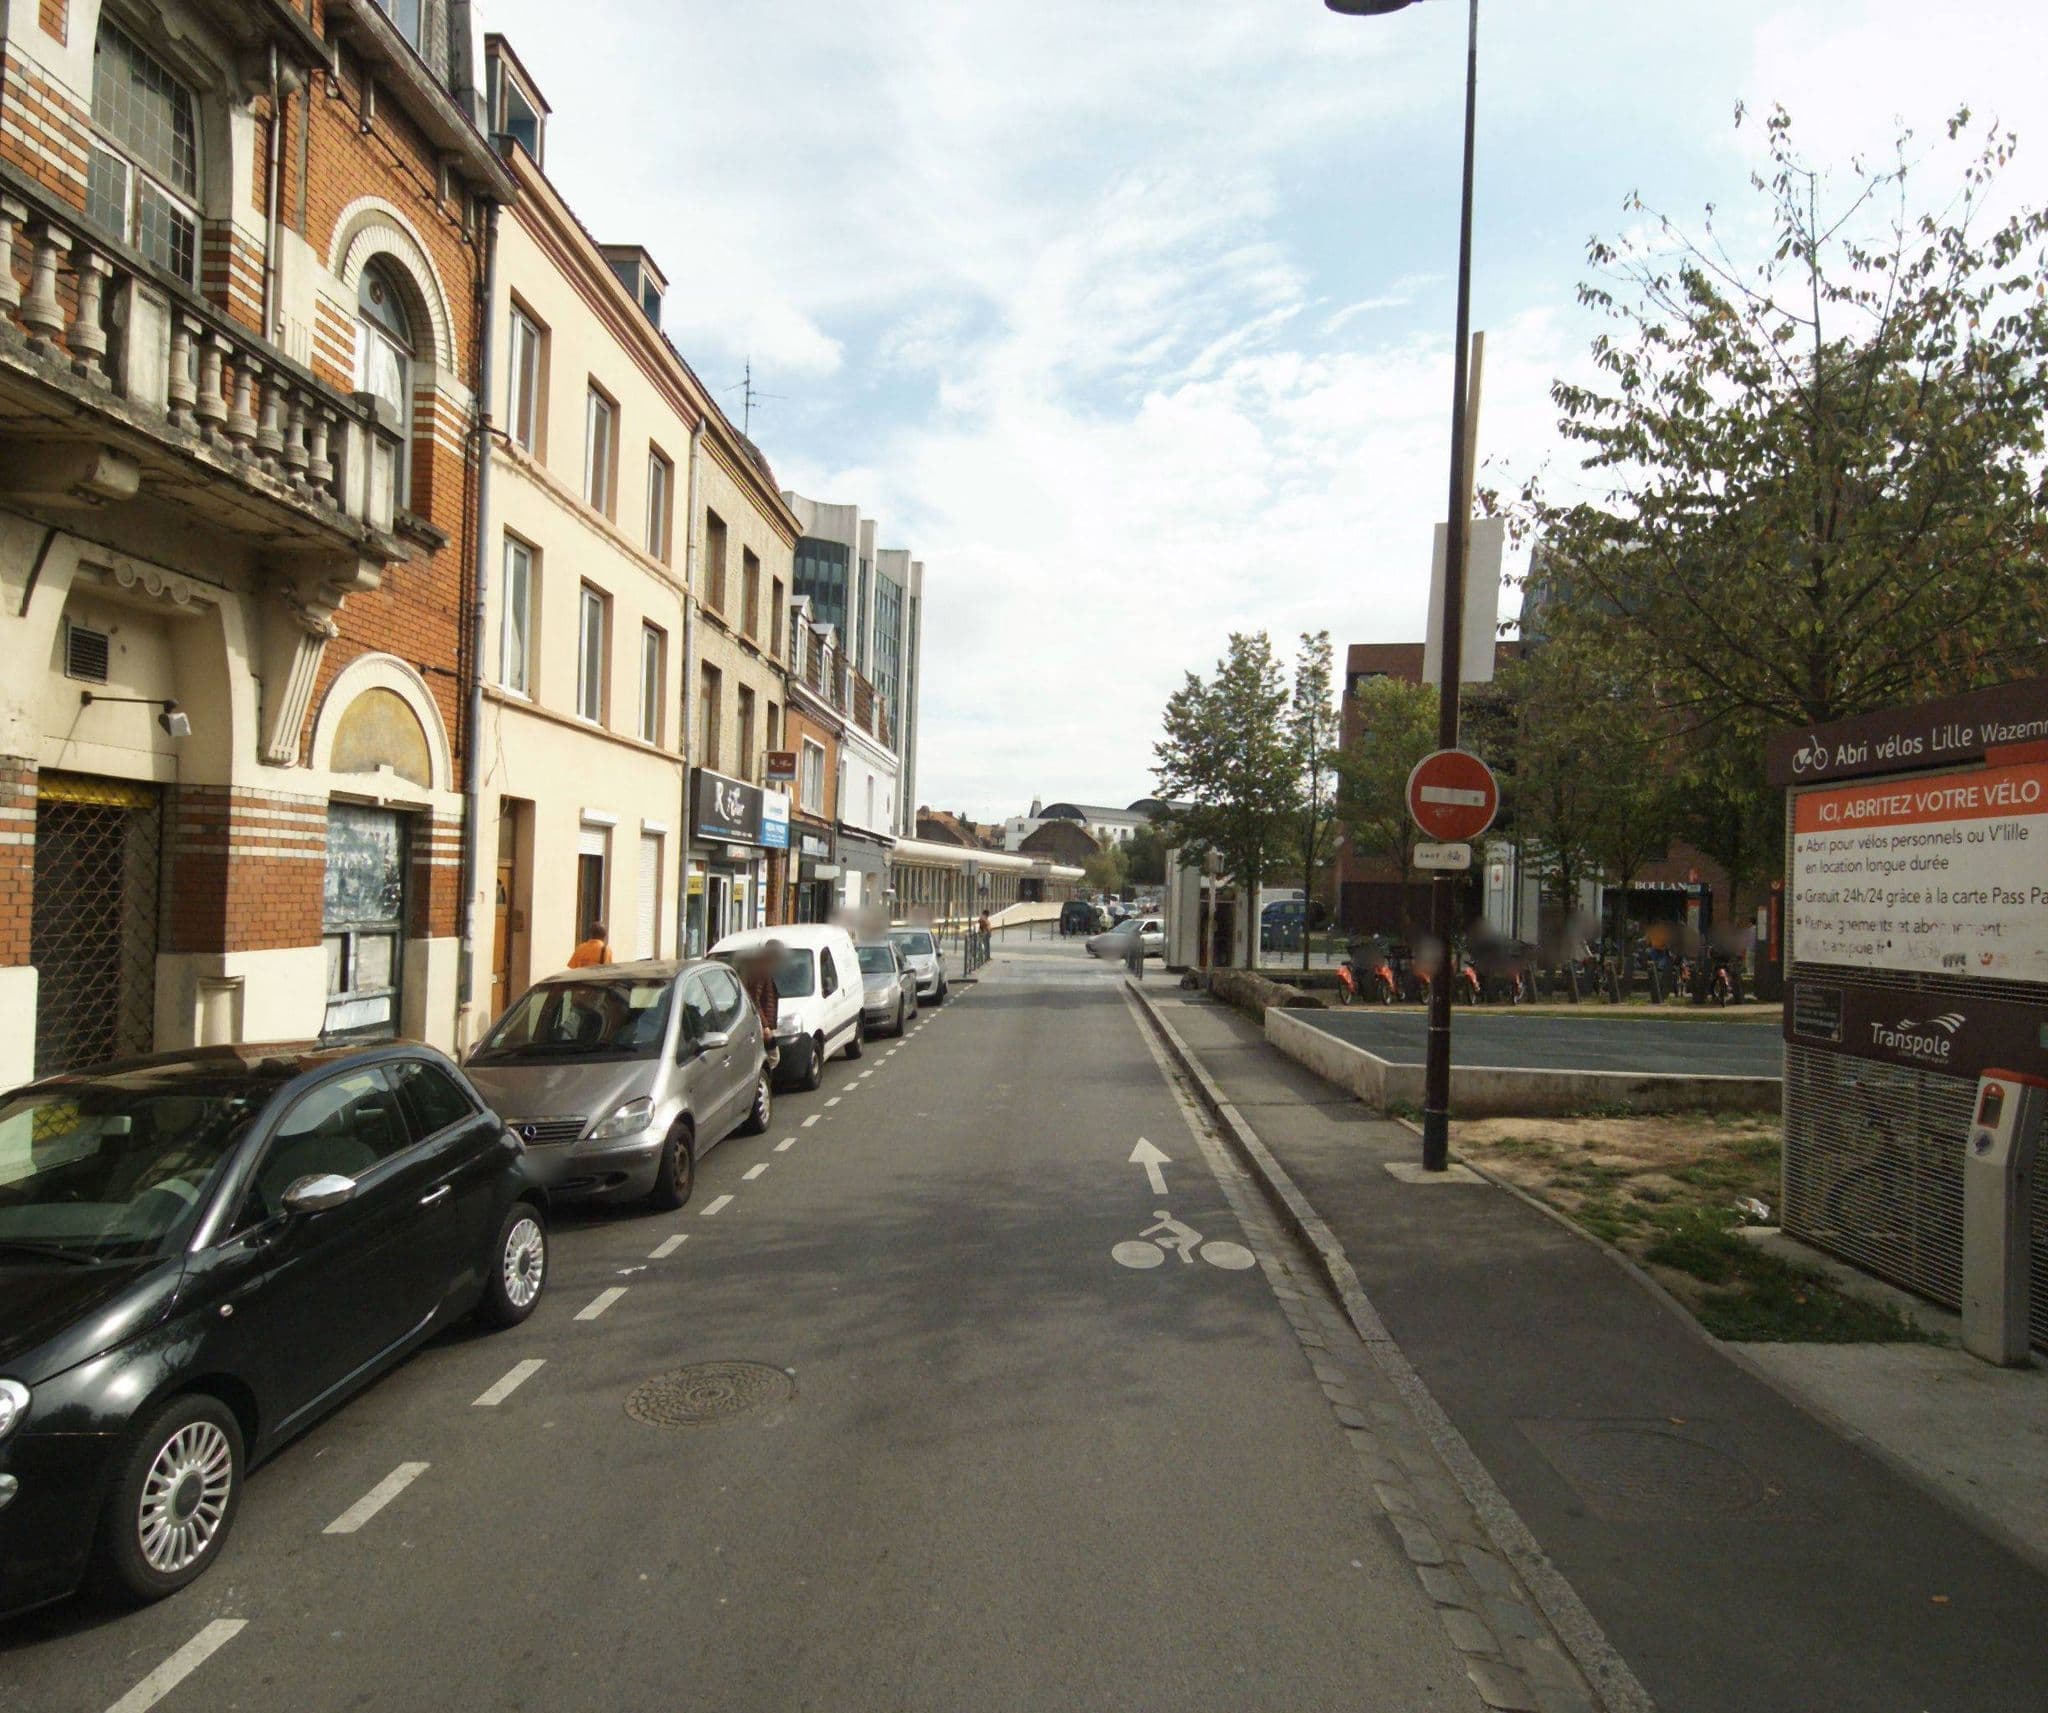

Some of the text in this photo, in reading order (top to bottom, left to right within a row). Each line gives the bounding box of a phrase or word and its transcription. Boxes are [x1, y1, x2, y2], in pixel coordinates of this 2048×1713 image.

[1835, 719, 2048, 766] Abri vélos Lille Wazem
[1843, 794, 1913, 819] ABRITEZ
[1915, 786, 1979, 812] VOTRE
[1983, 778, 2040, 806] VÉLO
[1805, 837, 1826, 853] Abri
[1829, 839, 1854, 855] pour
[1859, 833, 1888, 849] vélos
[1891, 827, 1963, 852] personnels
[1967, 831, 1985, 843] ou
[1805, 853, 1949, 876] en location longue durée
[1804, 888, 1841, 903] Gratuit
[1843, 887, 1884, 903] 24h/24
[1886, 888, 1921, 908] grâce
[1925, 887, 1933, 904] à
[1936, 887, 1948, 904] la
[1952, 889, 1988, 904] carte
[1992, 887, 2025, 905] Pass
[1870, 1022, 1951, 1057] Transpole
